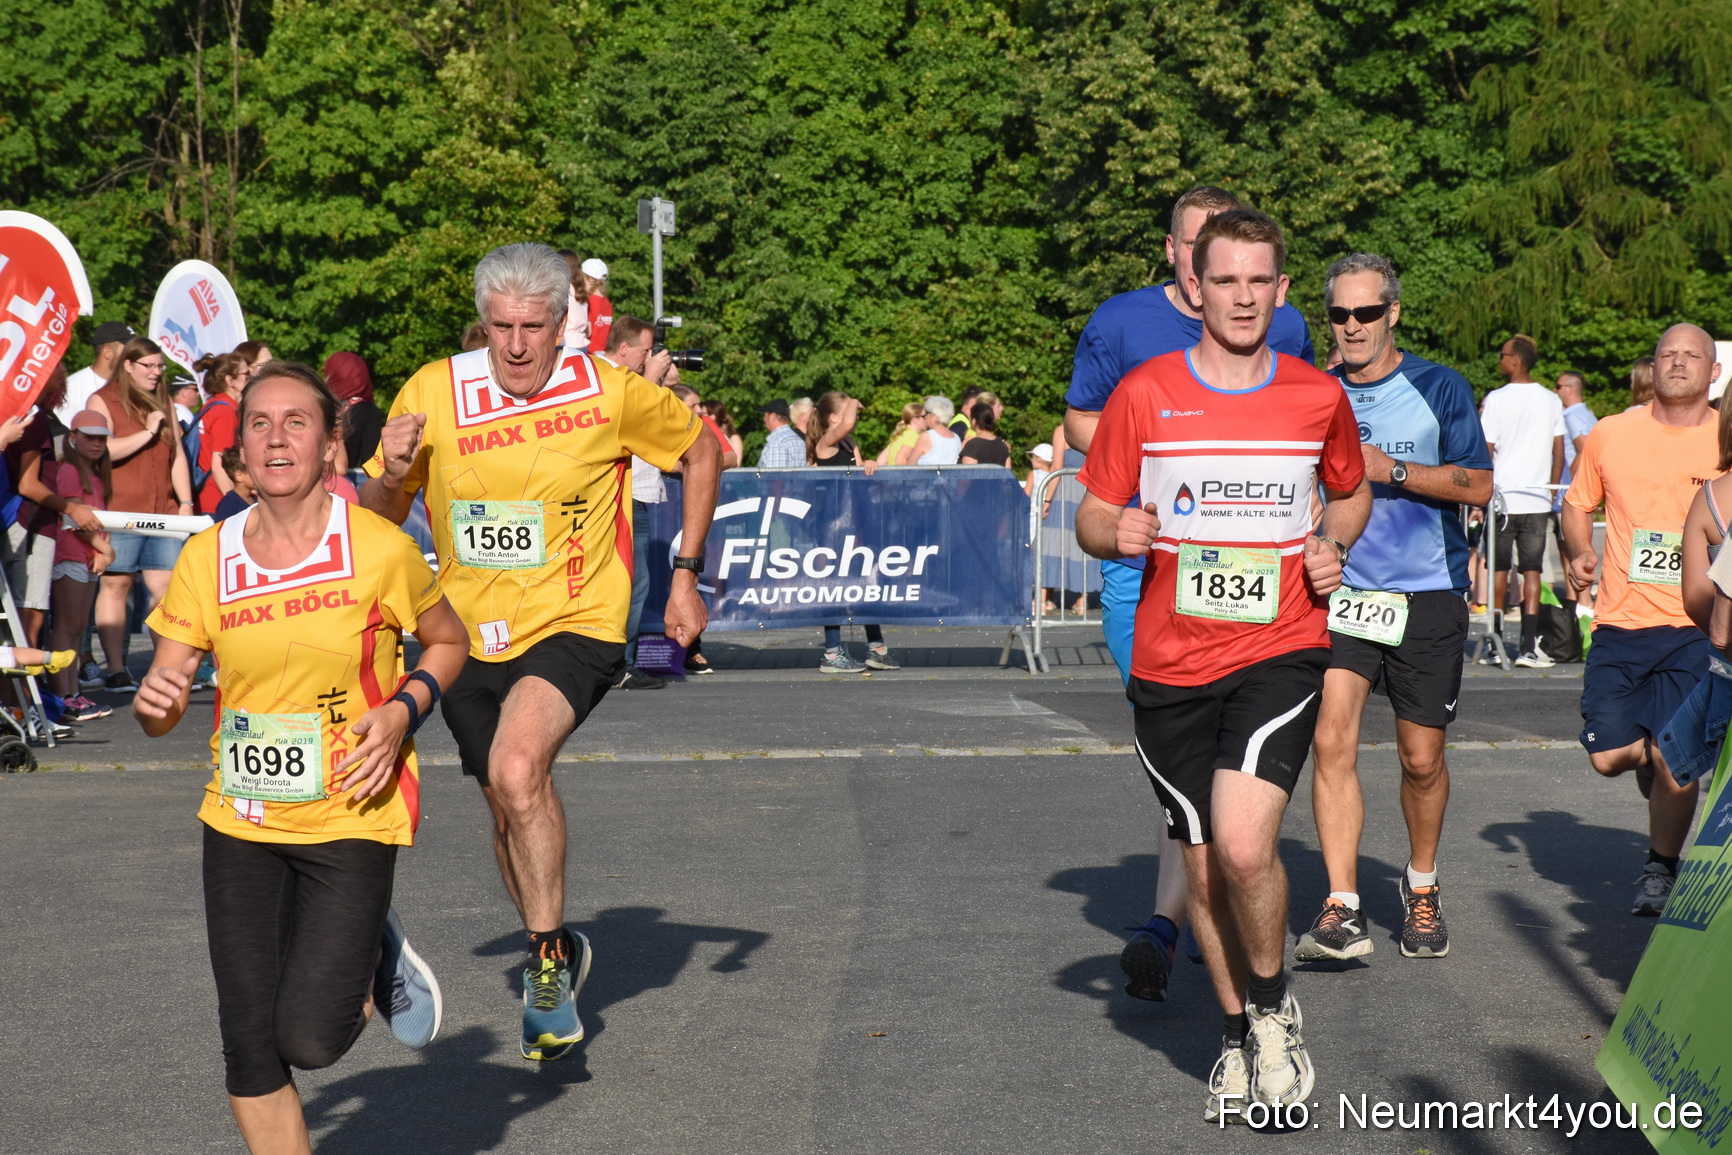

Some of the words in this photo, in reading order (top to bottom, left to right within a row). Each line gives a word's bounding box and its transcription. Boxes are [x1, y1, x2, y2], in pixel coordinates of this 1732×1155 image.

[457, 424, 527, 456] MAX
[534, 406, 610, 439] BÖGL
[1201, 481, 1296, 505] Petry
[1200, 509, 1233, 517] WÄRME
[1236, 508, 1265, 517] KÄLTE
[464, 525, 532, 550] 1568
[718, 535, 939, 580] Fischer
[1639, 549, 1682, 571] 228
[738, 584, 921, 605] AUTOMOBILE
[1191, 572, 1266, 602] 1834
[220, 604, 275, 632] MAX
[284, 589, 359, 617] BÖGL
[1205, 599, 1224, 607] Seitz
[1225, 601, 1249, 609] Lukas
[1335, 599, 1396, 627] 2120
[1339, 619, 1368, 629] Schneider
[292, 737, 313, 745] 2019
[229, 742, 305, 777] 1698
[241, 776, 261, 786] Weigl
[263, 778, 291, 786] Dorota
